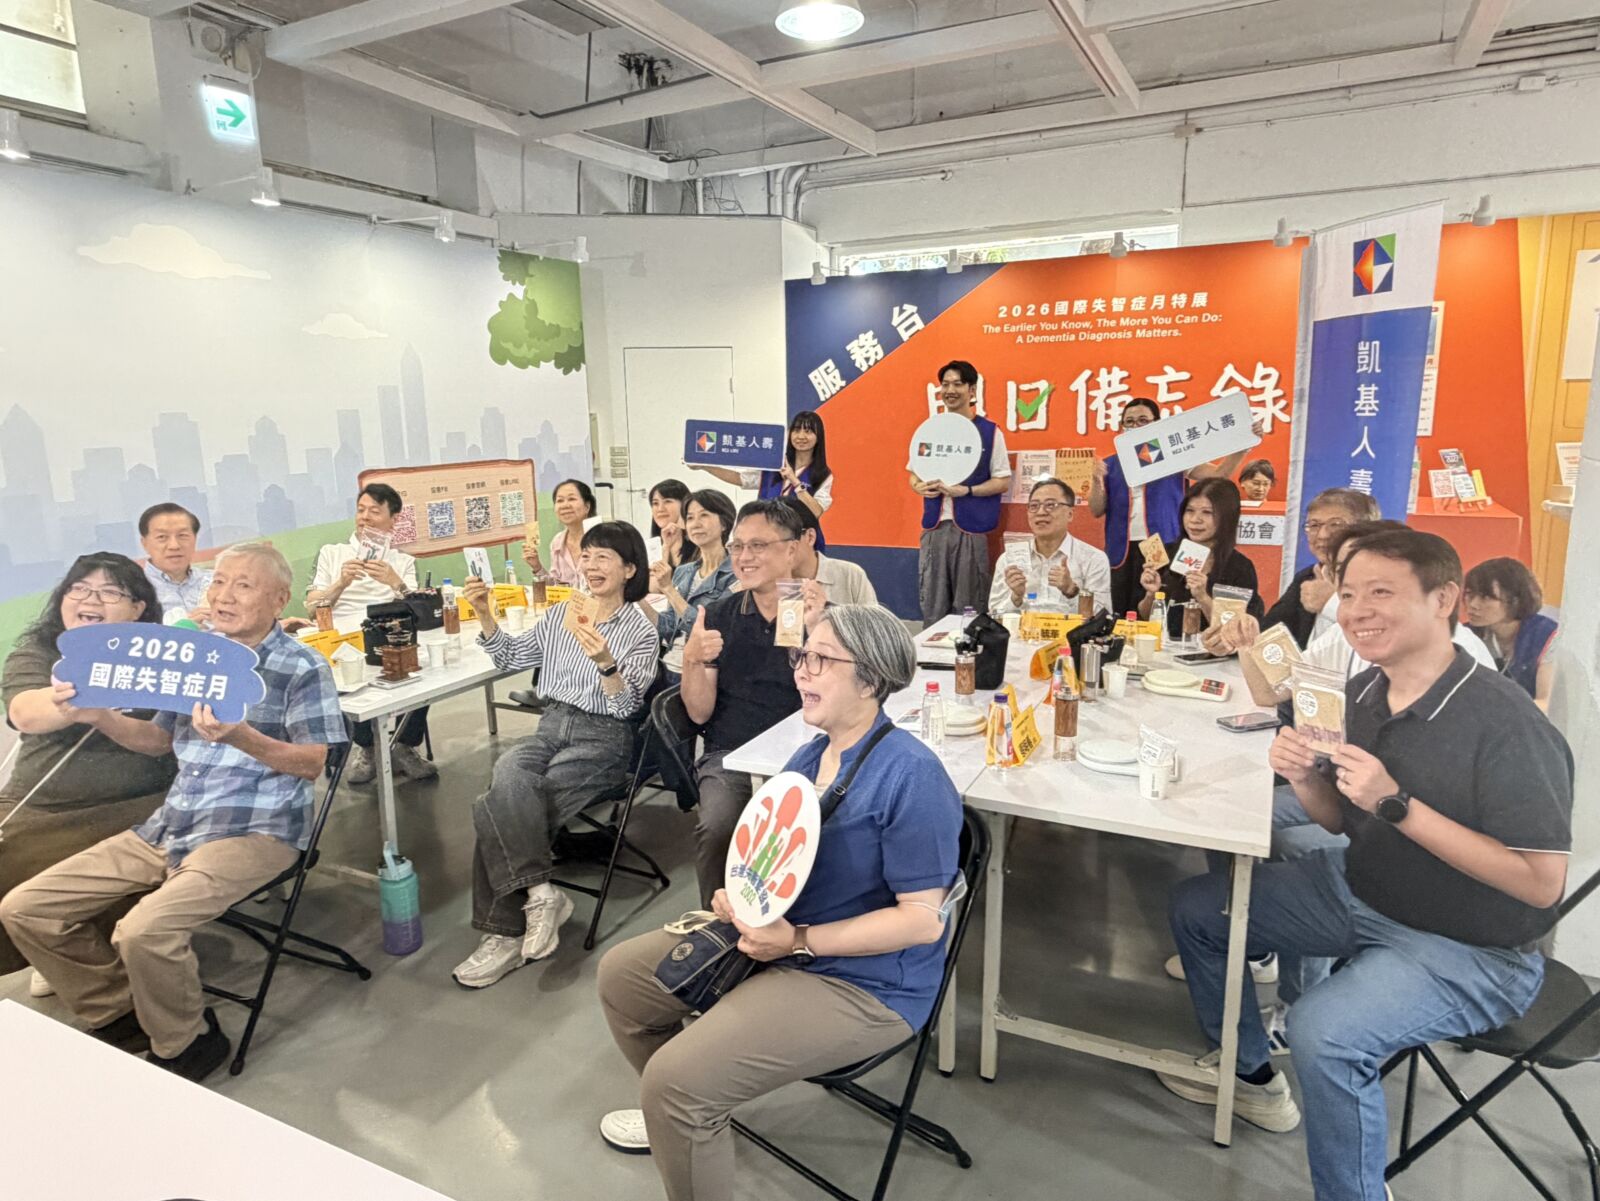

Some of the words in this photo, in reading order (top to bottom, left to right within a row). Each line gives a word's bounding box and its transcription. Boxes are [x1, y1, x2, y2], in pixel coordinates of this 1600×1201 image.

[998, 292, 1208, 318] 2026國際失智症月特展
[983, 324, 1001, 334] The
[1004, 322, 1037, 333] Earlier
[1039, 321, 1058, 331] You
[1061, 319, 1093, 330] Know,
[1097, 318, 1116, 328] The
[1120, 316, 1148, 327] More
[1151, 315, 1172, 325] You
[1175, 314, 1198, 324] Can
[1201, 313, 1223, 323] Do:
[1015, 335, 1024, 344] A
[1026, 332, 1075, 343] Dementia
[1078, 330, 1133, 342] Diagnosis
[1136, 328, 1182, 339] Matters.
[808, 303, 925, 401] 服務台
[1167, 413, 1236, 448] 凱基人壽
[1349, 341, 1382, 496] 凱基人壽
[721, 434, 774, 449] 凱基人壽
[1238, 520, 1276, 539] 協會
[128, 636, 196, 663] 2026
[88, 662, 228, 701] 國際失智症月
